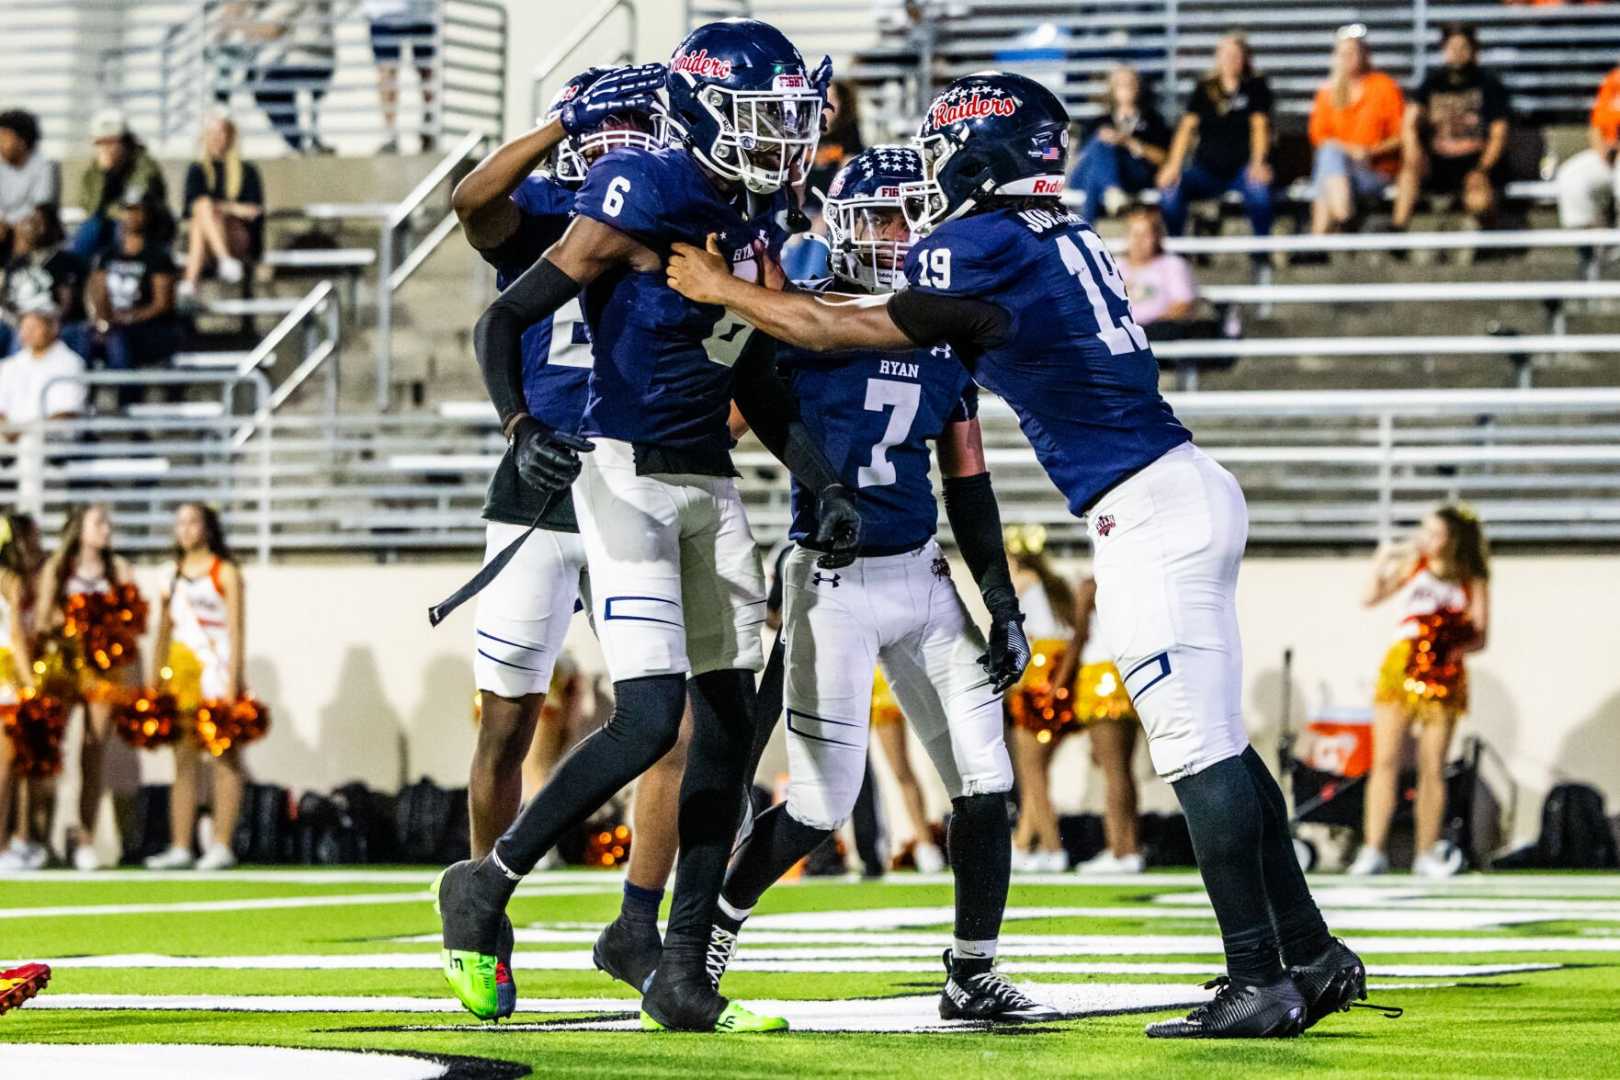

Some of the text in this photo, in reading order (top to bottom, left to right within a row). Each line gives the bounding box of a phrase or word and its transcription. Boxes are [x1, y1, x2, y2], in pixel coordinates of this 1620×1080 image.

[933, 94, 1015, 130] Raiders
[602, 176, 631, 217] 6
[918, 248, 951, 289] 19
[1056, 229, 1149, 355] 19
[880, 360, 919, 378] RYAN
[858, 378, 921, 488] 7
[944, 978, 972, 1009] NIKE
